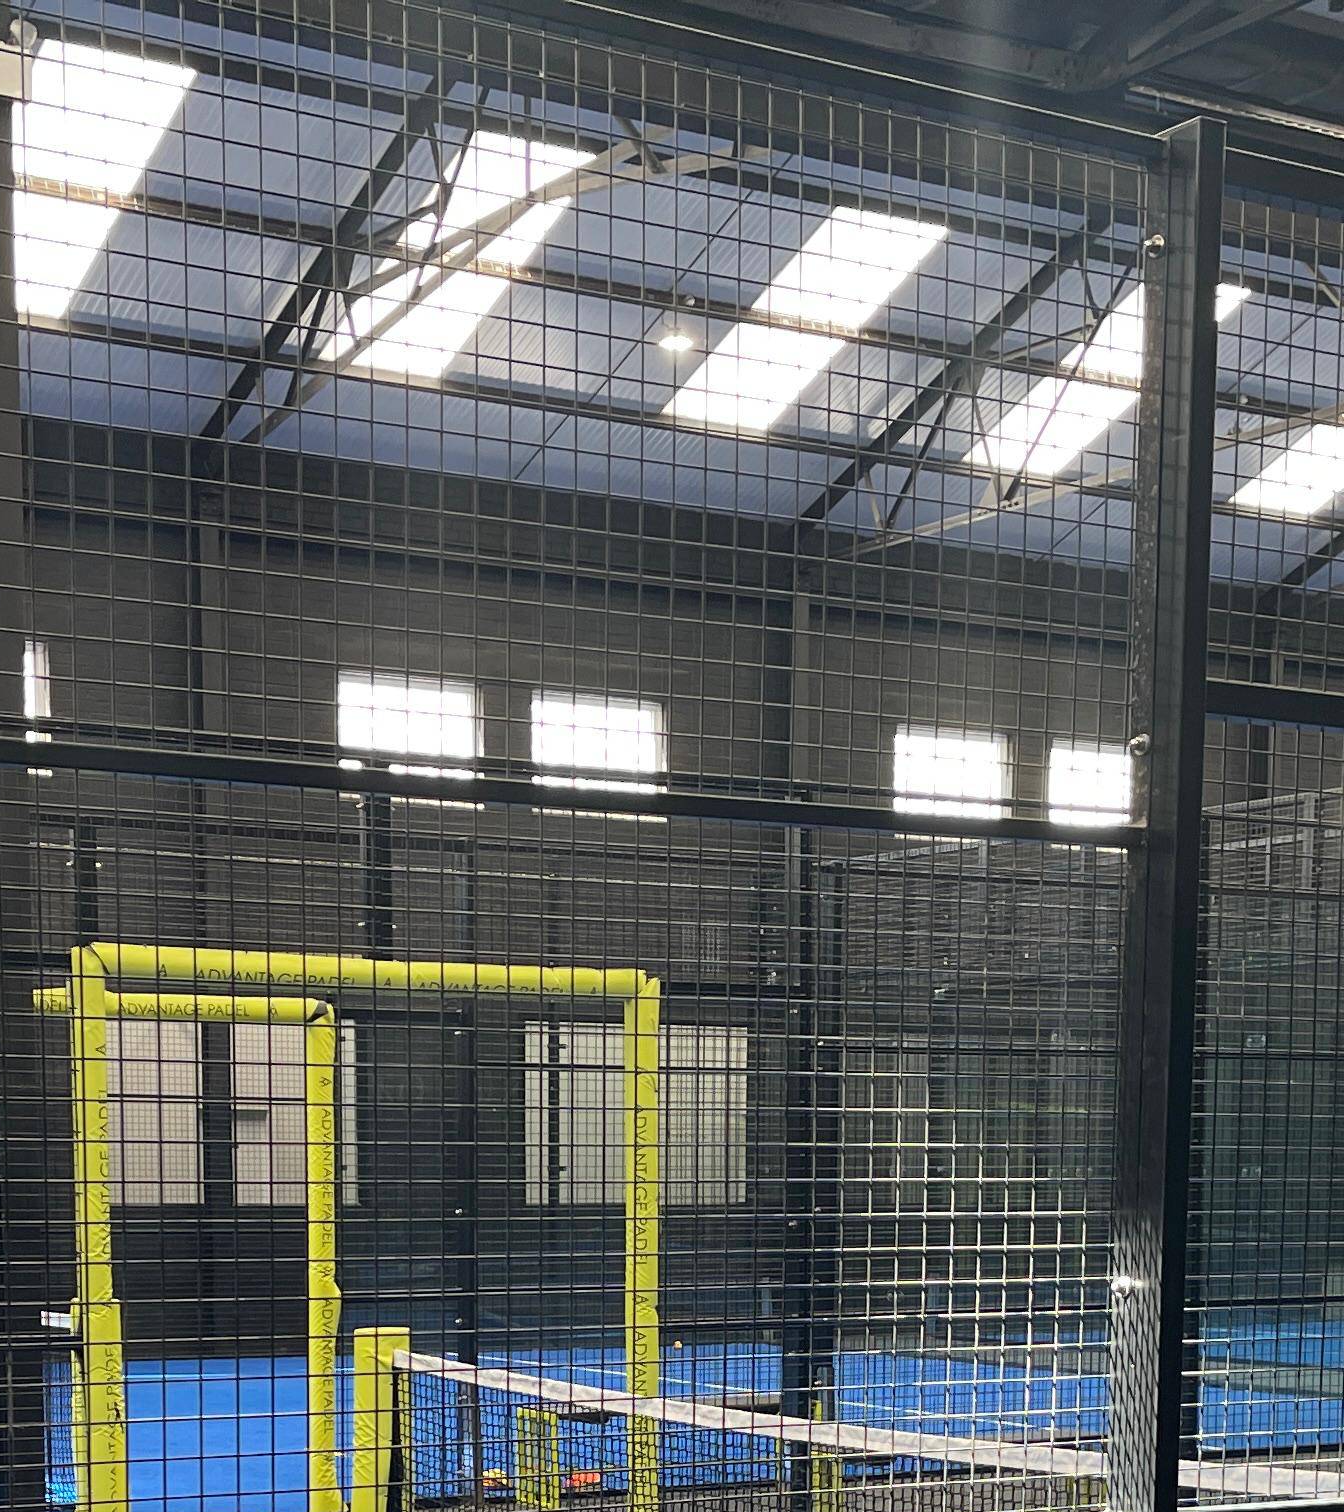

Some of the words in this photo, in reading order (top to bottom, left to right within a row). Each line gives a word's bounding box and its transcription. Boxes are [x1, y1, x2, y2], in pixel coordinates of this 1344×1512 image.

[119, 1002, 204, 1017] ADVANTAGE
[208, 1003, 250, 1017] PADEL
[321, 1108, 334, 1202] ADVANTAGE
